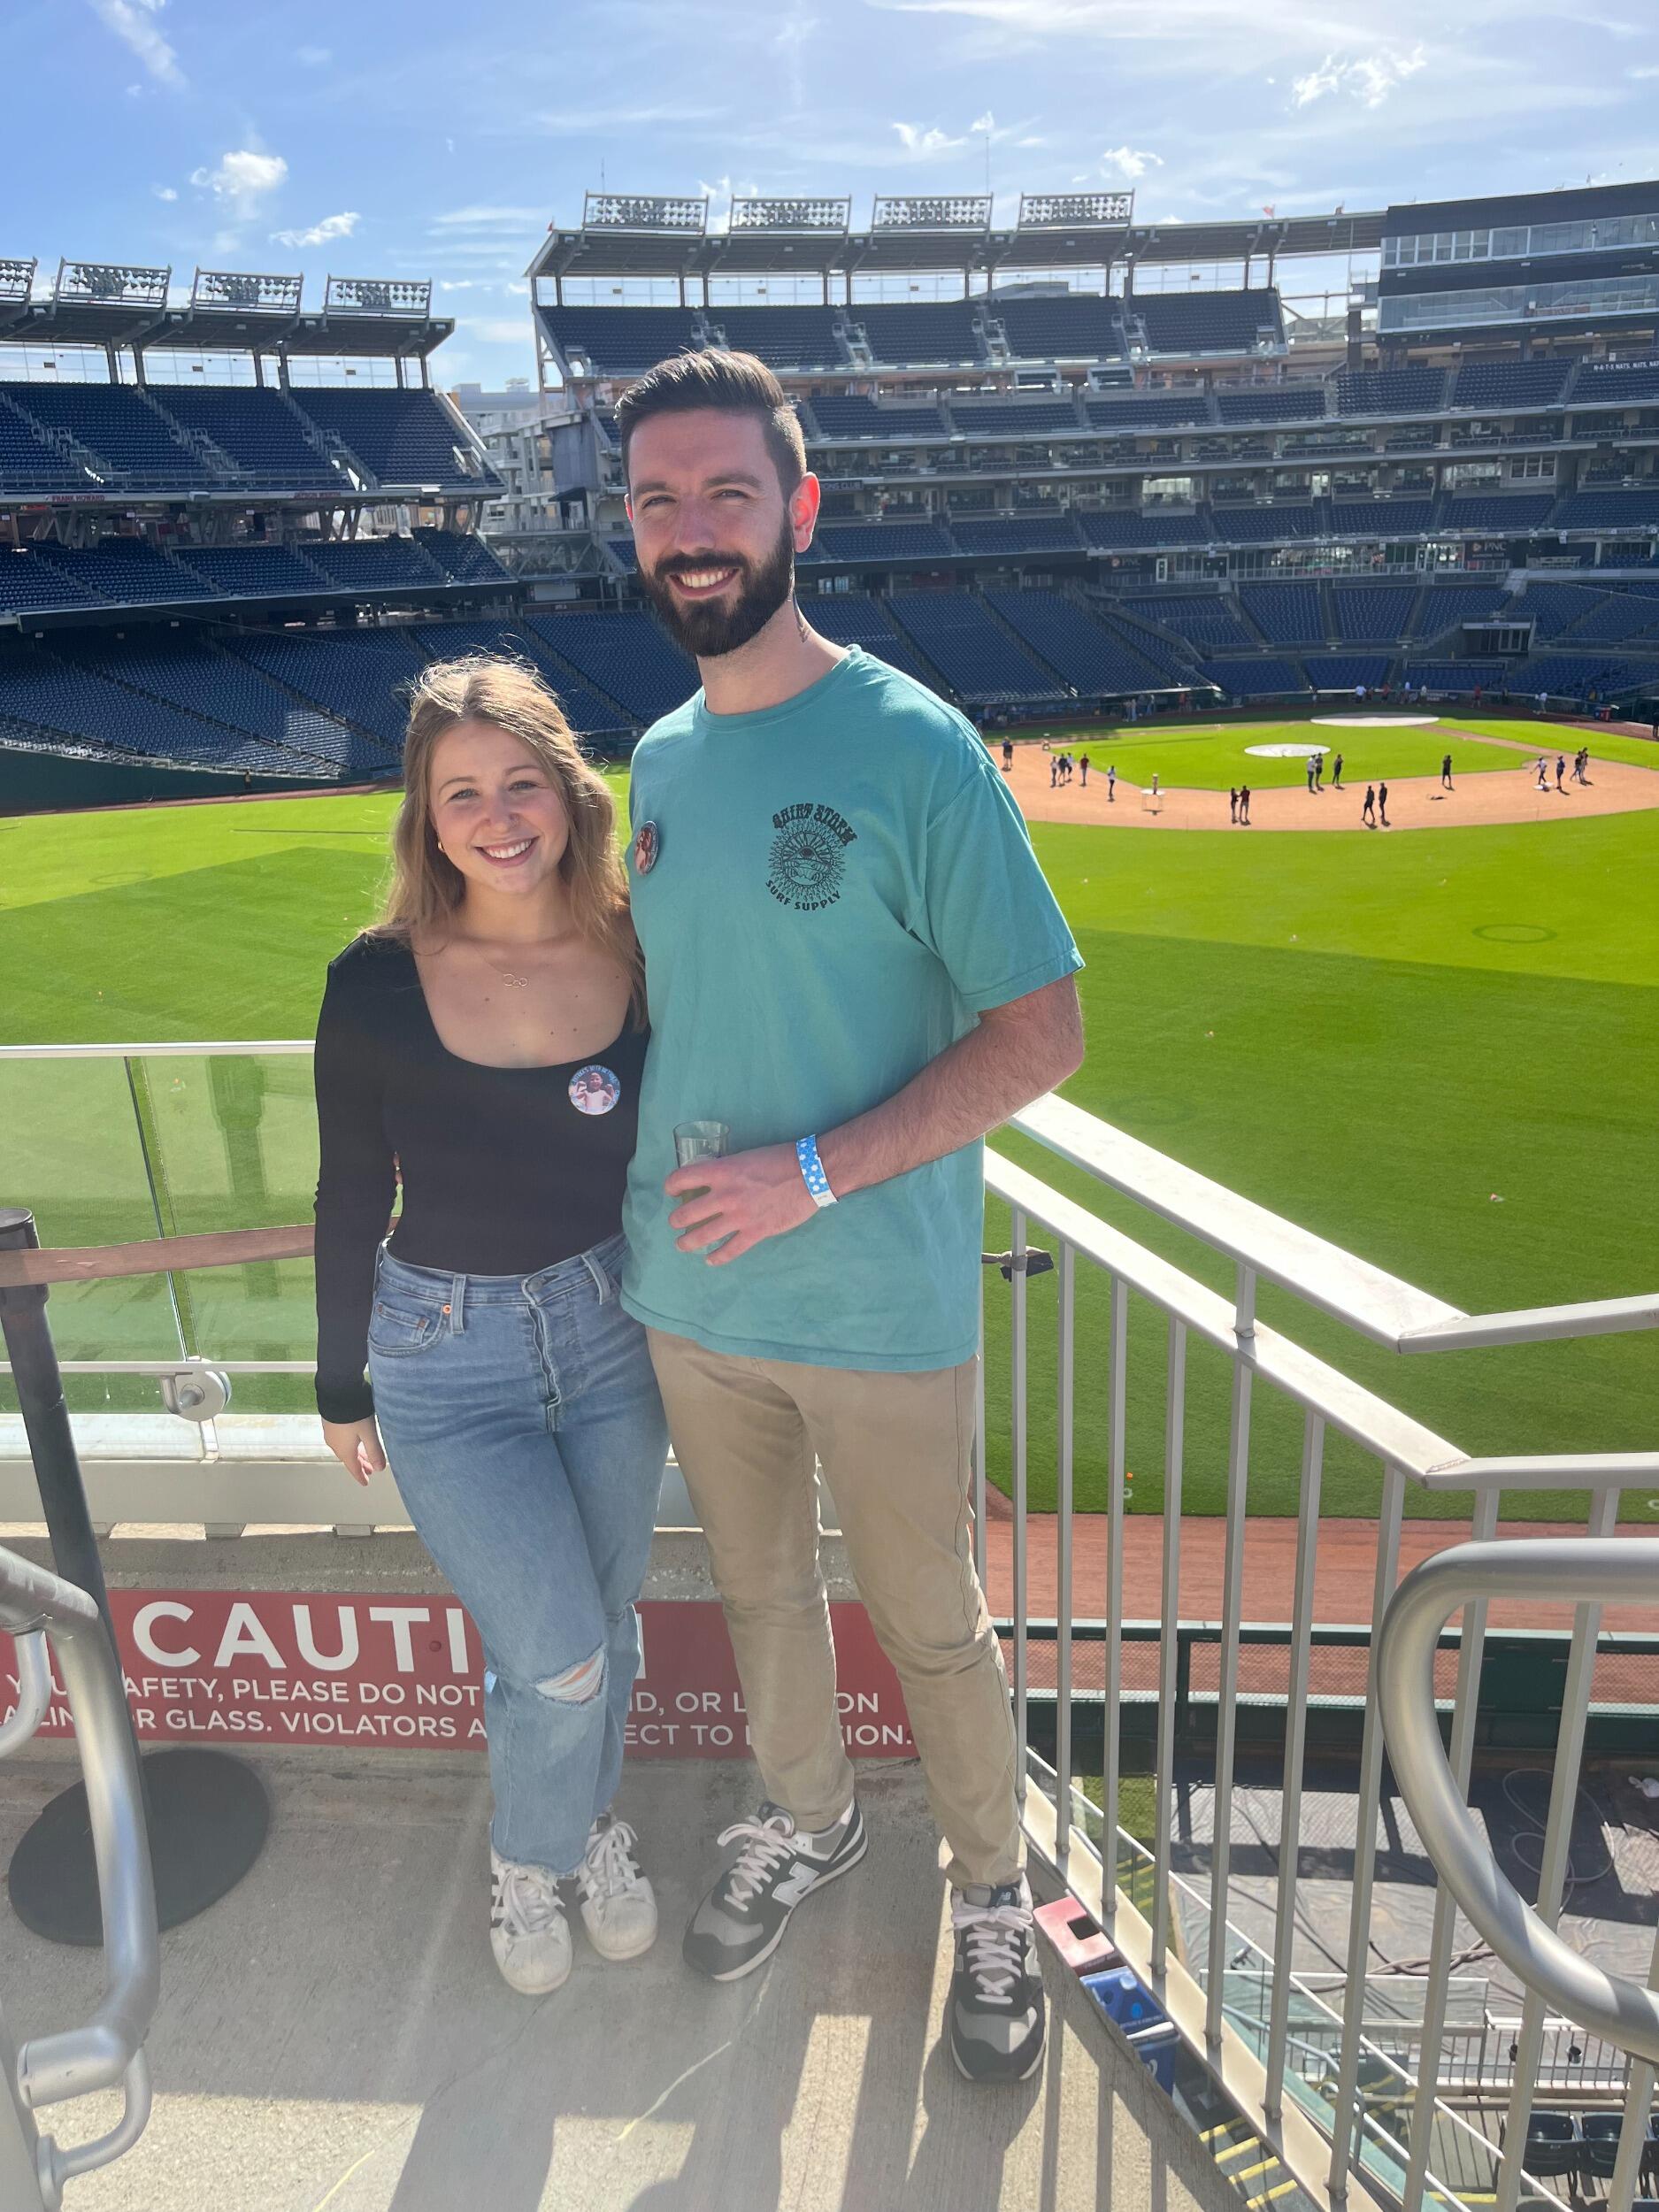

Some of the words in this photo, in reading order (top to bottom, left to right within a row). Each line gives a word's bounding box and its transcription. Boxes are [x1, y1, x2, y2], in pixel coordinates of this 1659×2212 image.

[765, 879, 791, 905] SURF
[794, 890, 841, 910] SUPPLY
[122, 1675, 224, 1702] AFETY,
[232, 1678, 349, 1702] PLEASE
[359, 1683, 405, 1704] DO
[416, 1684, 480, 1706] NOT
[675, 1692, 721, 1713] OR
[165, 1708, 273, 1732] GLASS.
[280, 1711, 457, 1737] VIOLATORS
[690, 1724, 733, 1746] TO
